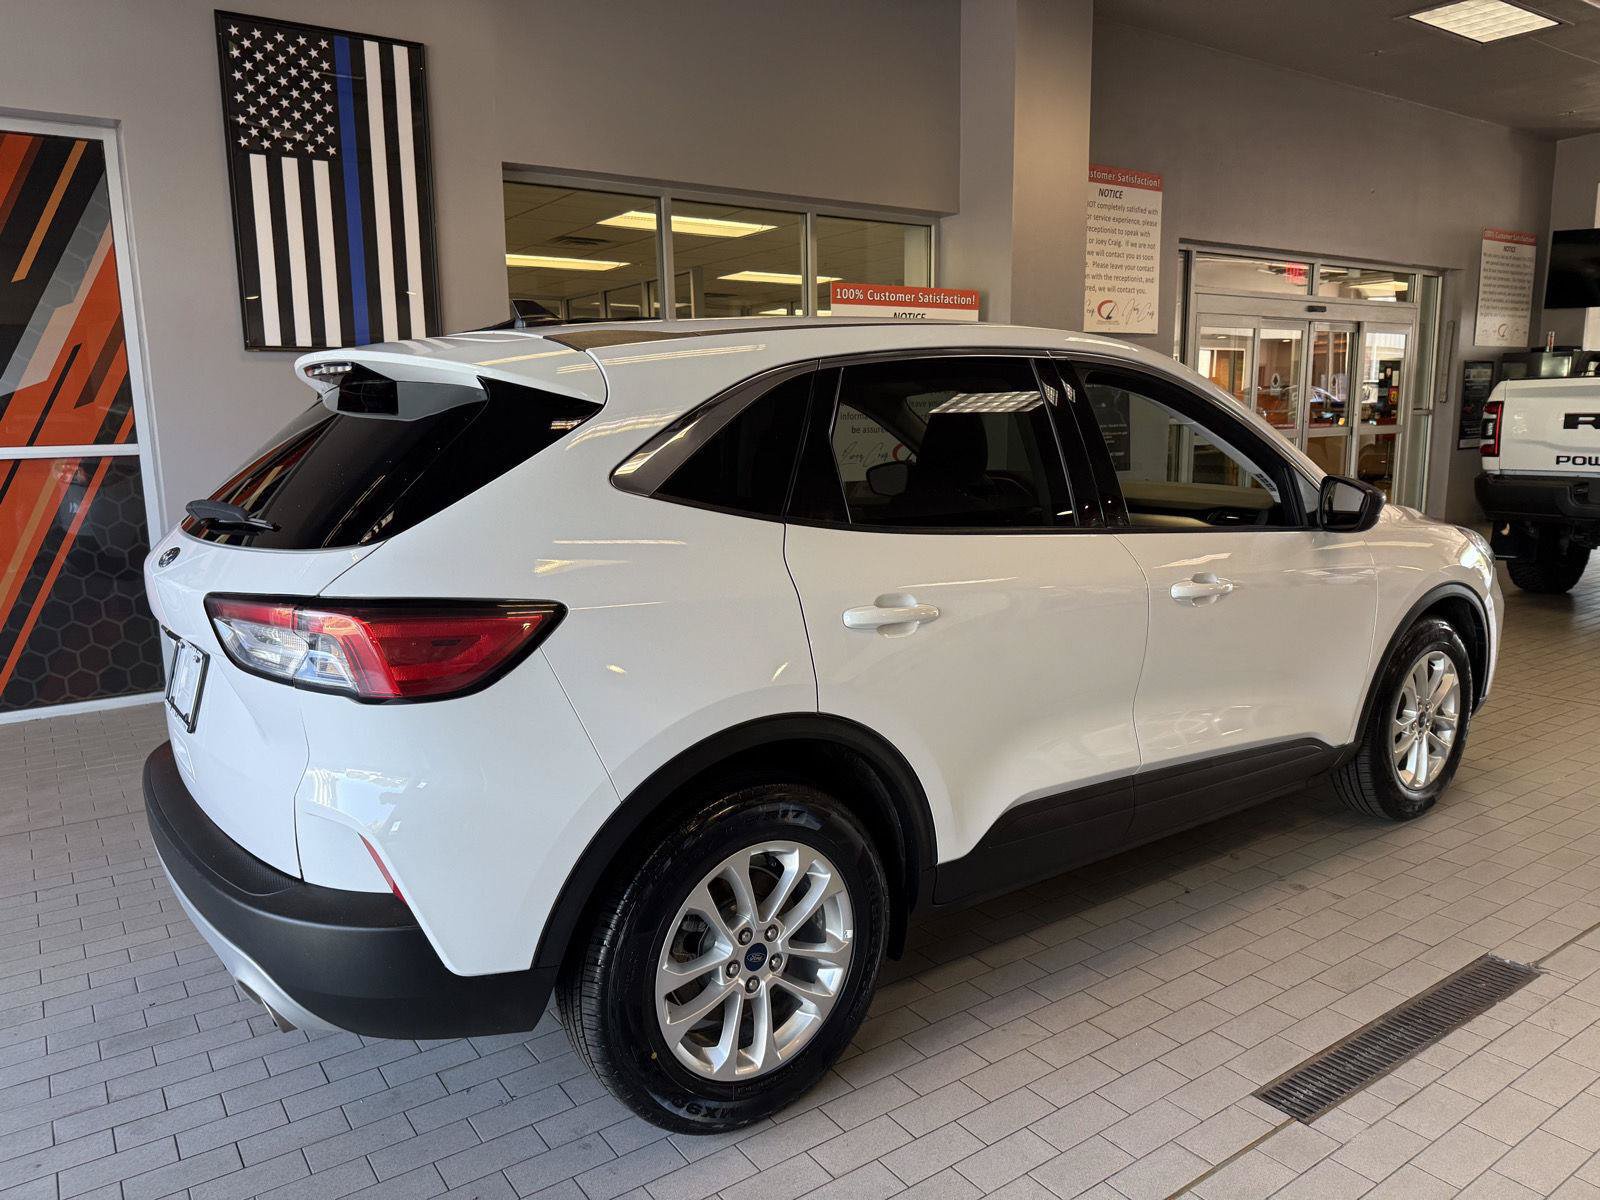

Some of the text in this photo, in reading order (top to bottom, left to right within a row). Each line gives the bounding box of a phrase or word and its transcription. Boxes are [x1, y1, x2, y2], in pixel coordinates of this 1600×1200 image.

[1117, 173, 1161, 187] Satisfaction!
[1098, 188, 1123, 199] NOTICE
[1097, 203, 1125, 212] completely
[1126, 206, 1146, 214] satisfied
[1147, 208, 1159, 216] with
[1093, 215, 1111, 223] service
[1086, 226, 1117, 234] receptionist
[1095, 238, 1107, 246] Joey
[1092, 261, 1109, 269] Please
[1109, 262, 1123, 270] leave
[1136, 265, 1154, 273] contact
[1103, 273, 1112, 281] the
[835, 288, 976, 305] 100% Customer Satisfaction!
[851, 426, 861, 434] be
